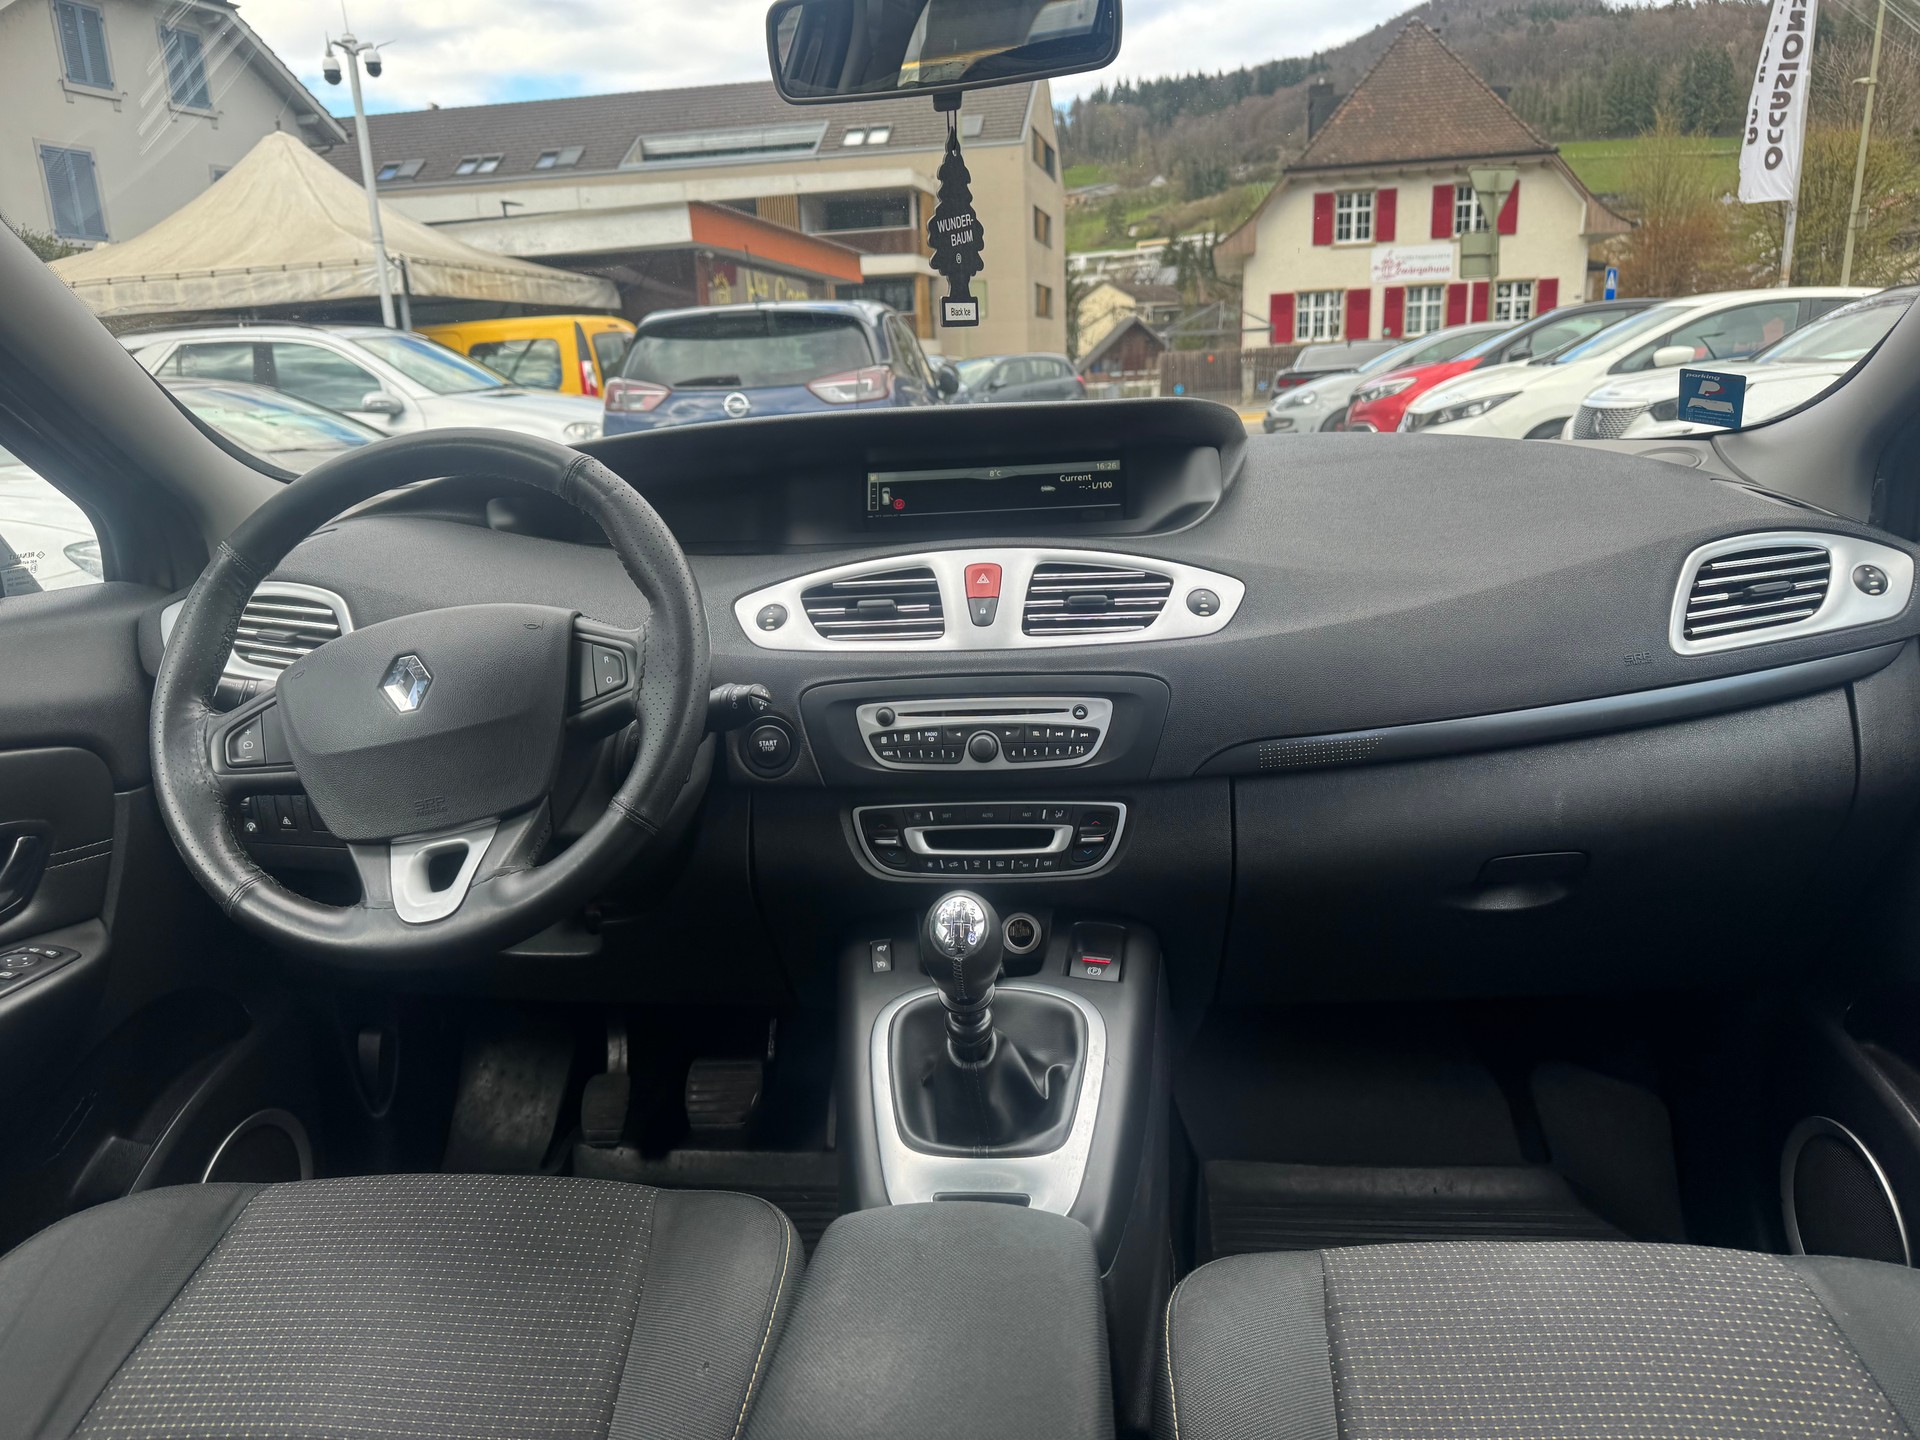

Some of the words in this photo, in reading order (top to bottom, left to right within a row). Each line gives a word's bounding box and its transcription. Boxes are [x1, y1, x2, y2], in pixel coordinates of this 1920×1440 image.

[936, 213, 974, 233] WUNDER-
[950, 229, 974, 247] BAUM
[950, 307, 963, 317] Black
[963, 308, 971, 316] Ice
[1685, 372, 1720, 381] parking
[1059, 473, 1092, 482] Current
[758, 739, 778, 747] START
